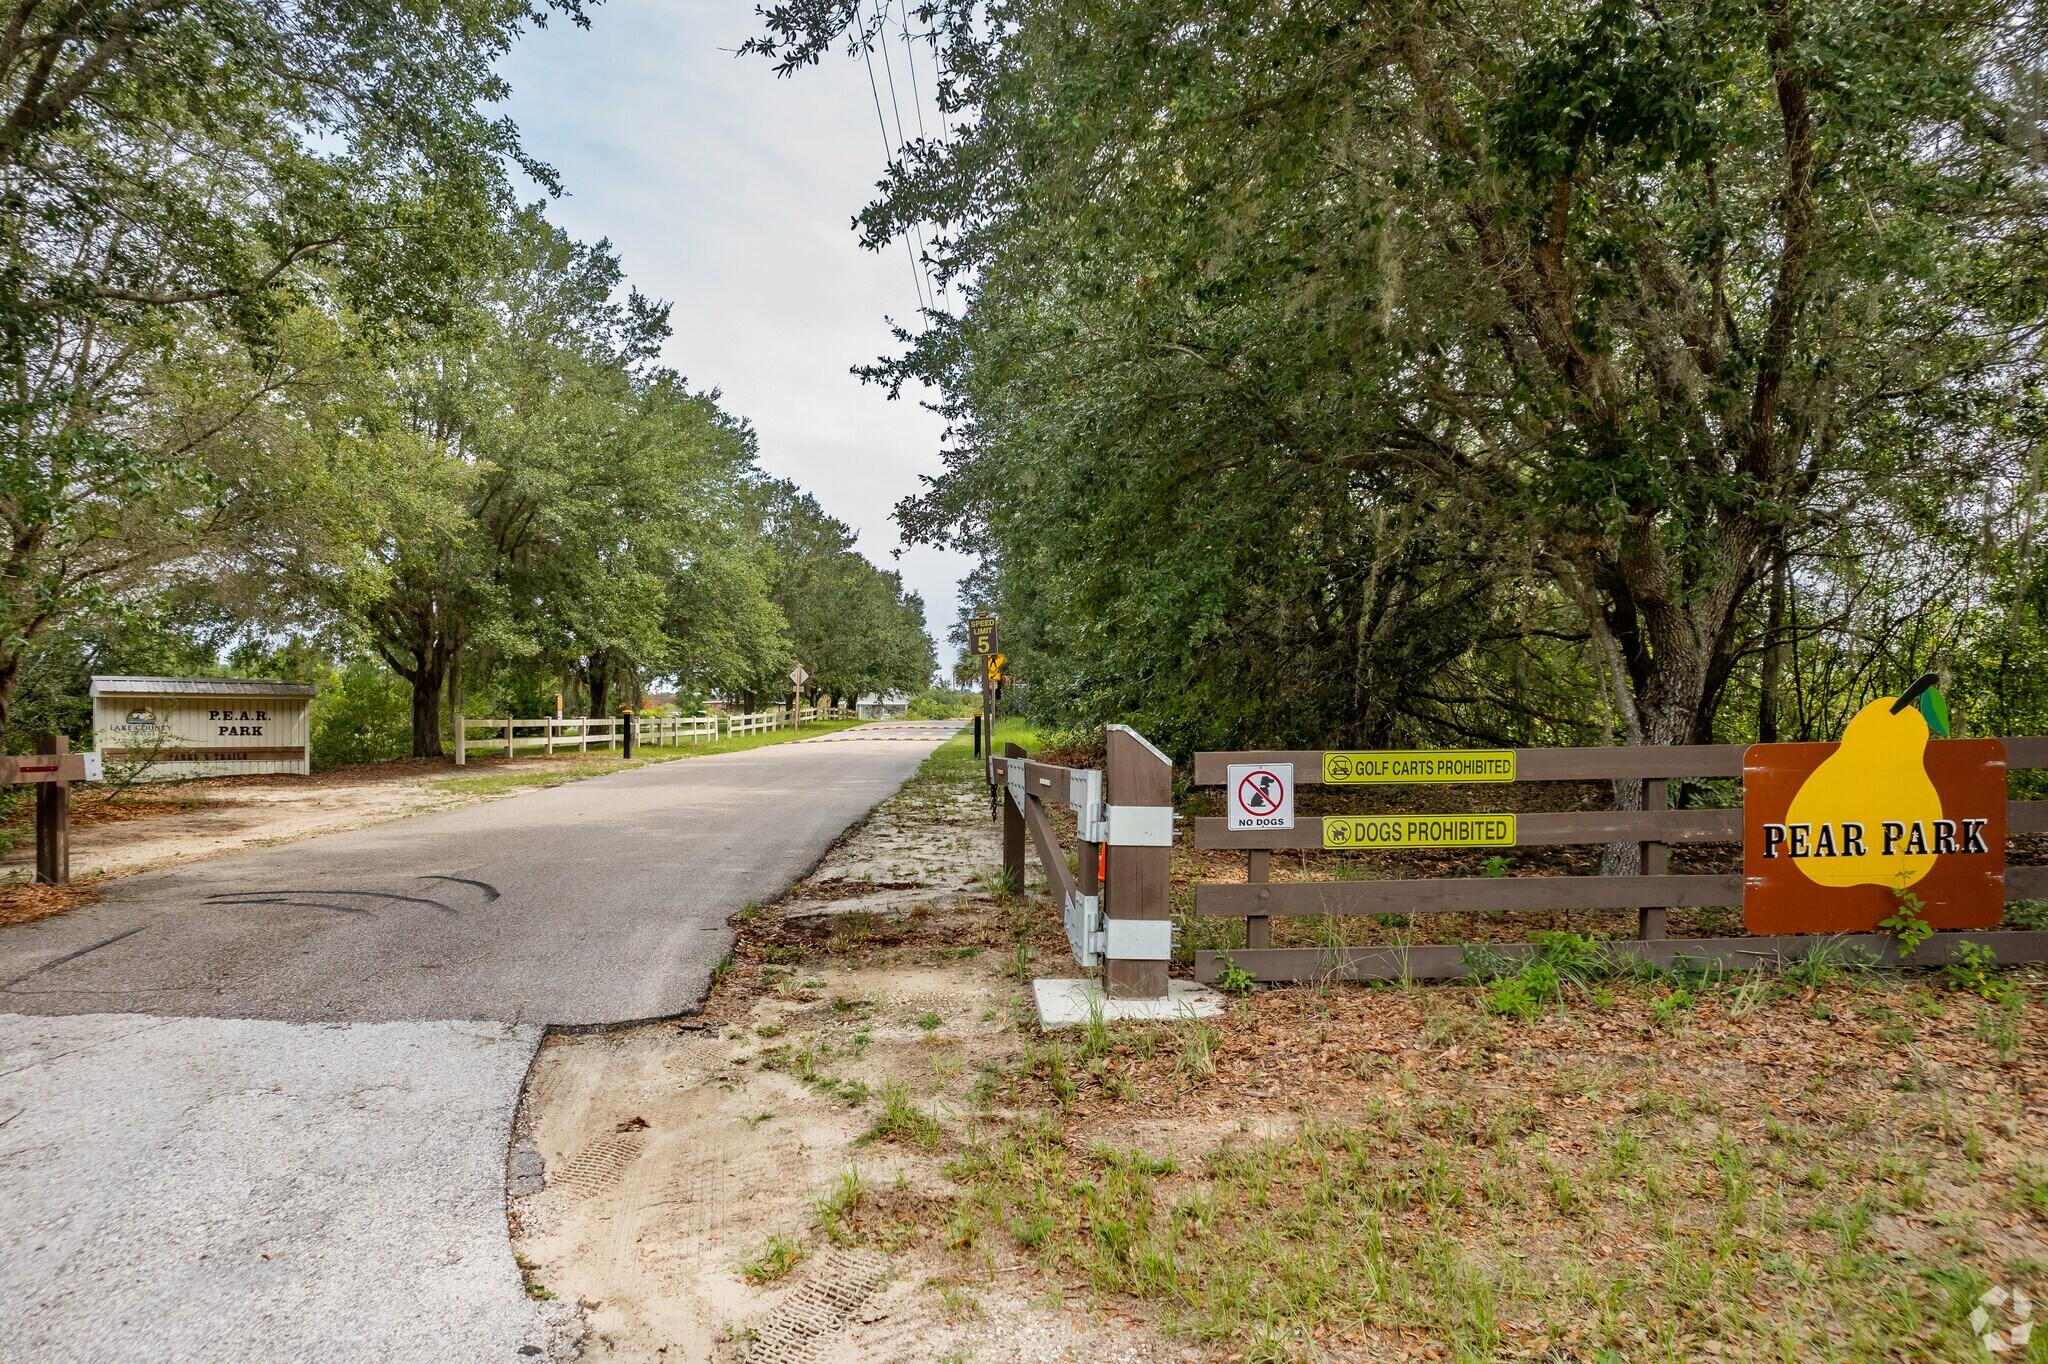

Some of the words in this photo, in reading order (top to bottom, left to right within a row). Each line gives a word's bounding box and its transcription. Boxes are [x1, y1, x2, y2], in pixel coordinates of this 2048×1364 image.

[971, 620, 994, 628] SPEED
[978, 636, 990, 653] 5
[208, 710, 272, 721] P.E.A.R.
[109, 724, 132, 732] LAKE
[218, 726, 263, 736] PARK
[1355, 760, 1389, 776] GOLF
[1392, 759, 1434, 776] CARTS
[1437, 758, 1511, 775] PROHIBITED
[1238, 819, 1253, 827] NO
[1256, 818, 1284, 826] DOGS
[1354, 823, 1402, 842] DOGS
[1407, 820, 1507, 842] PROHIBITED
[1763, 822, 1868, 859] PEAR
[1881, 818, 1989, 856] PARK
